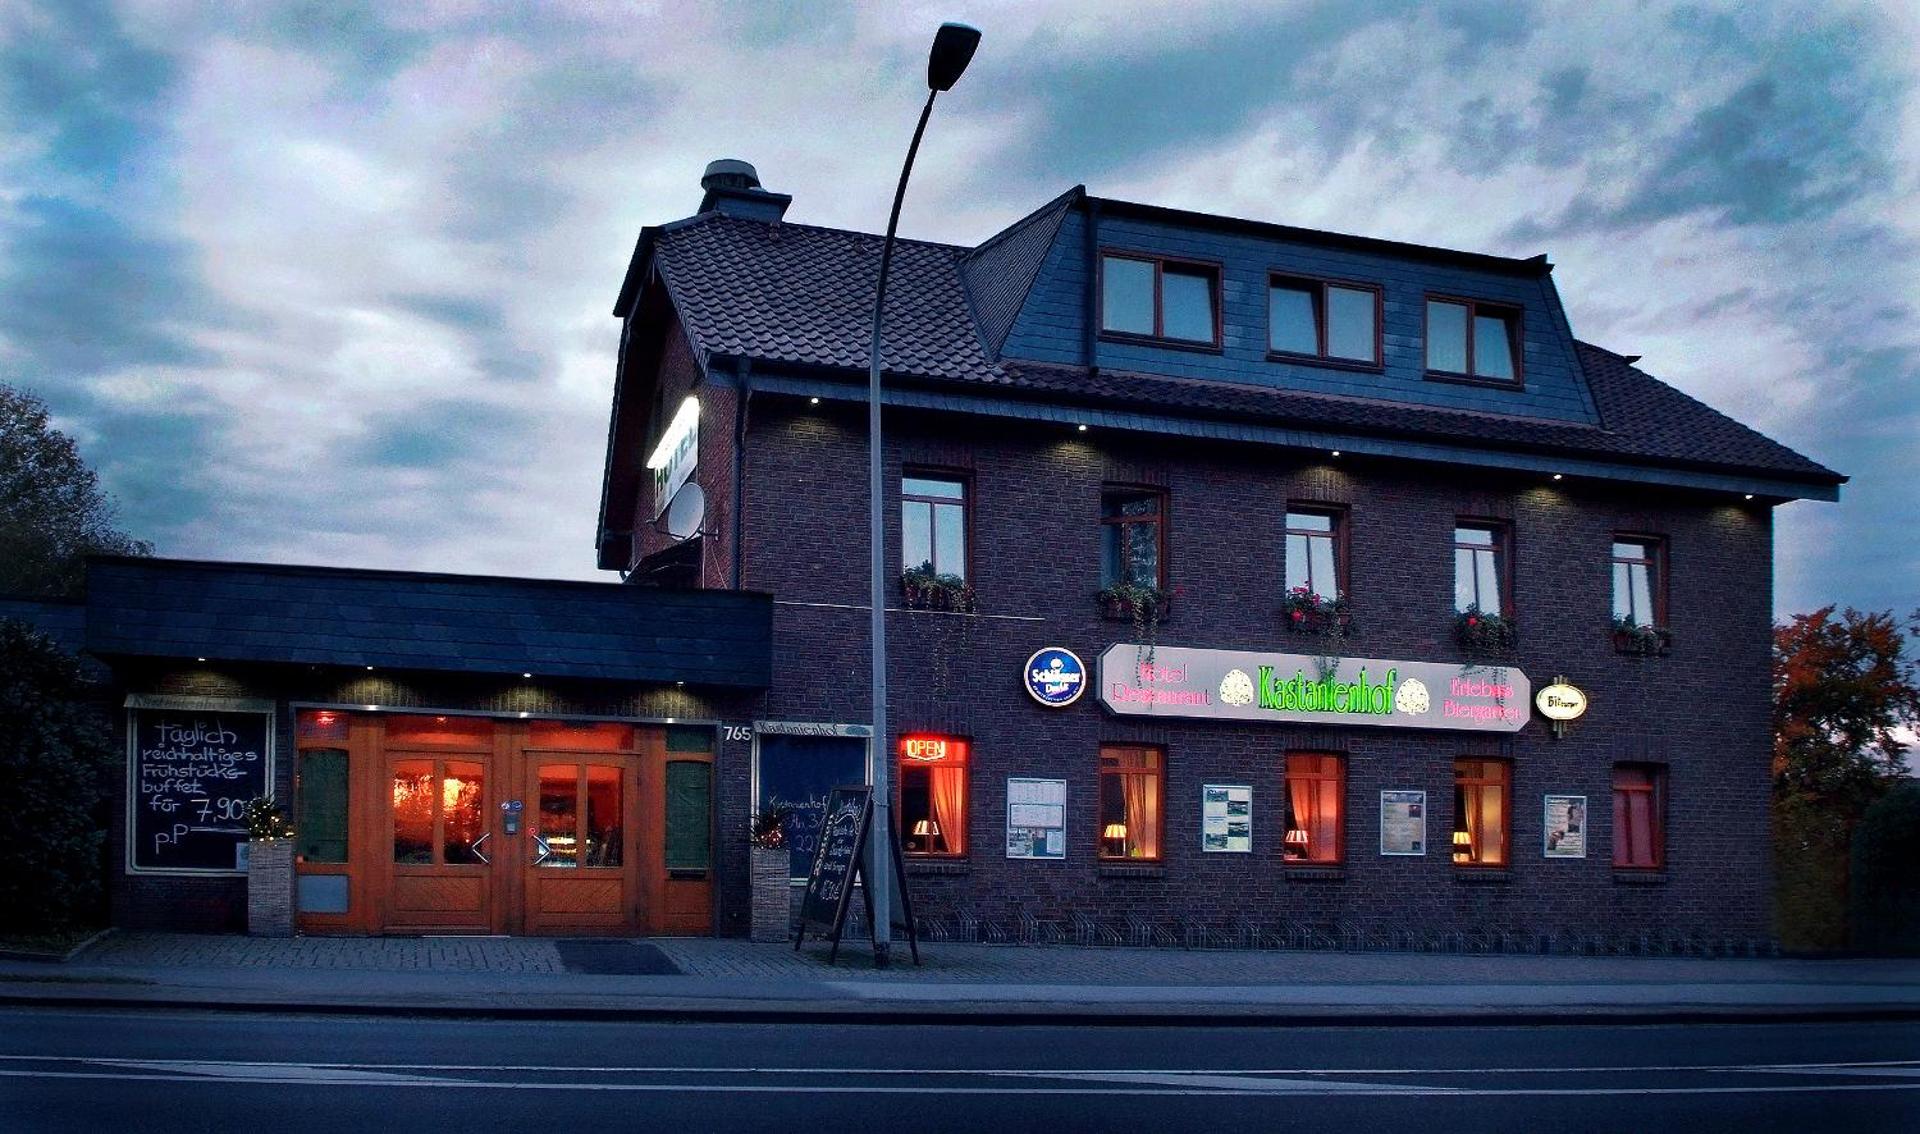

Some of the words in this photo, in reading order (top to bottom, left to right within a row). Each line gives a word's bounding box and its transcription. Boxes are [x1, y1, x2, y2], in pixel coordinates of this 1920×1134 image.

[1258, 664, 1398, 714] Kastanienhof
[723, 726, 751, 741] 765
[142, 743, 258, 768] reichhaltiges
[909, 739, 943, 757] OPEN
[141, 778, 207, 795] buffet
